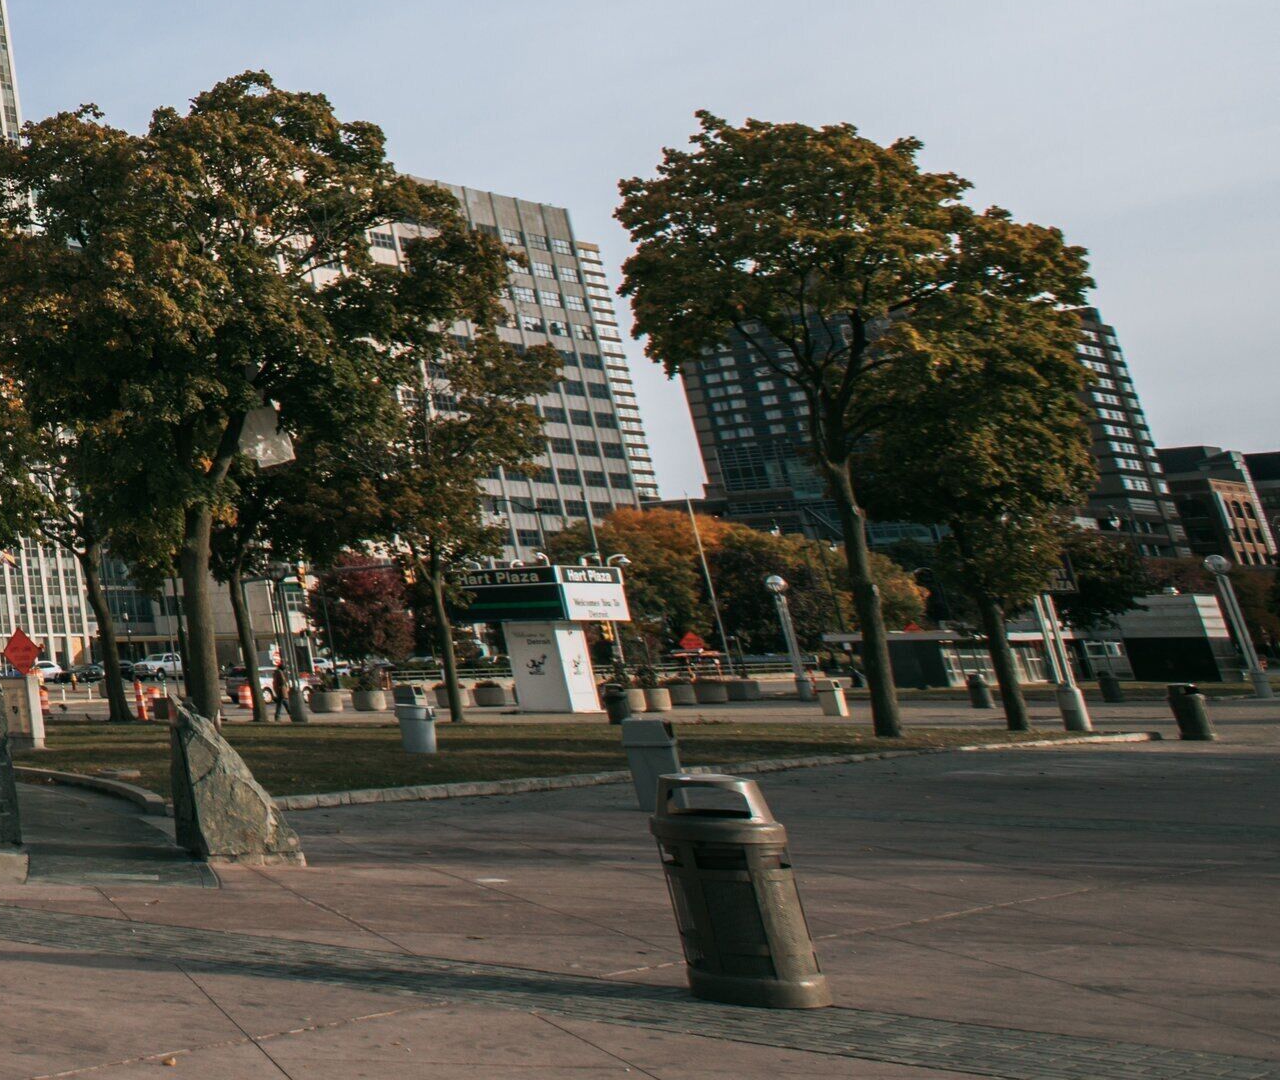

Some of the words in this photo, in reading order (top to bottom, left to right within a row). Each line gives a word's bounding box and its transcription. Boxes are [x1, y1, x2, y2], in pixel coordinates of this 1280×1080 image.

[457, 573, 492, 585] Hart
[494, 571, 540, 584] Plaza
[566, 569, 587, 581] Hart
[588, 569, 612, 582] Plaza
